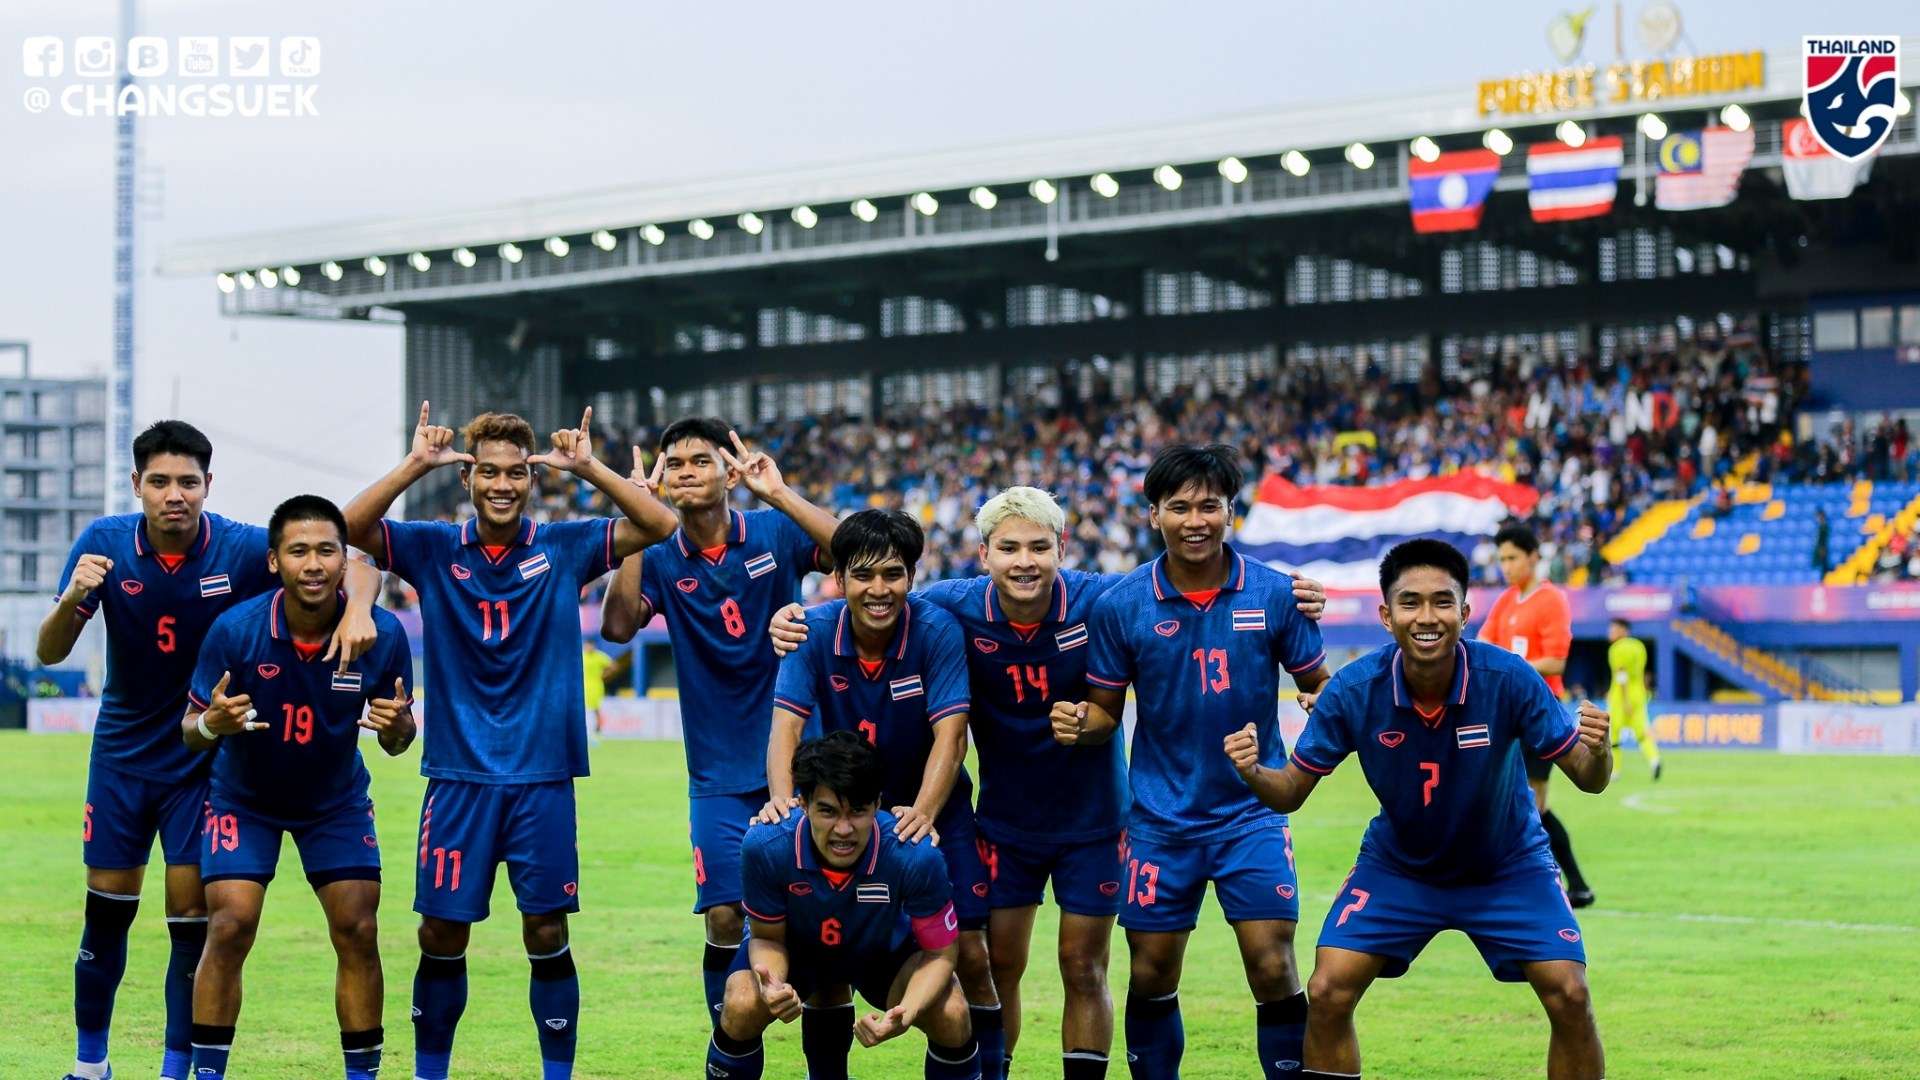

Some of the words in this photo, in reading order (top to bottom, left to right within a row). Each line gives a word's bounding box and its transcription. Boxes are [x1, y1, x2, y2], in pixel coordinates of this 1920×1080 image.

[157, 616, 176, 653] 5
[478, 600, 510, 641] 11
[719, 598, 746, 638] 8
[1006, 665, 1049, 703] 14
[1193, 648, 1230, 694] 13
[282, 703, 314, 744] 19
[1419, 762, 1440, 807] 7
[210, 813, 239, 855] 19
[433, 847, 462, 892] 11
[1127, 859, 1160, 907] 13
[1335, 888, 1371, 927] 7
[820, 917, 842, 945] 6
